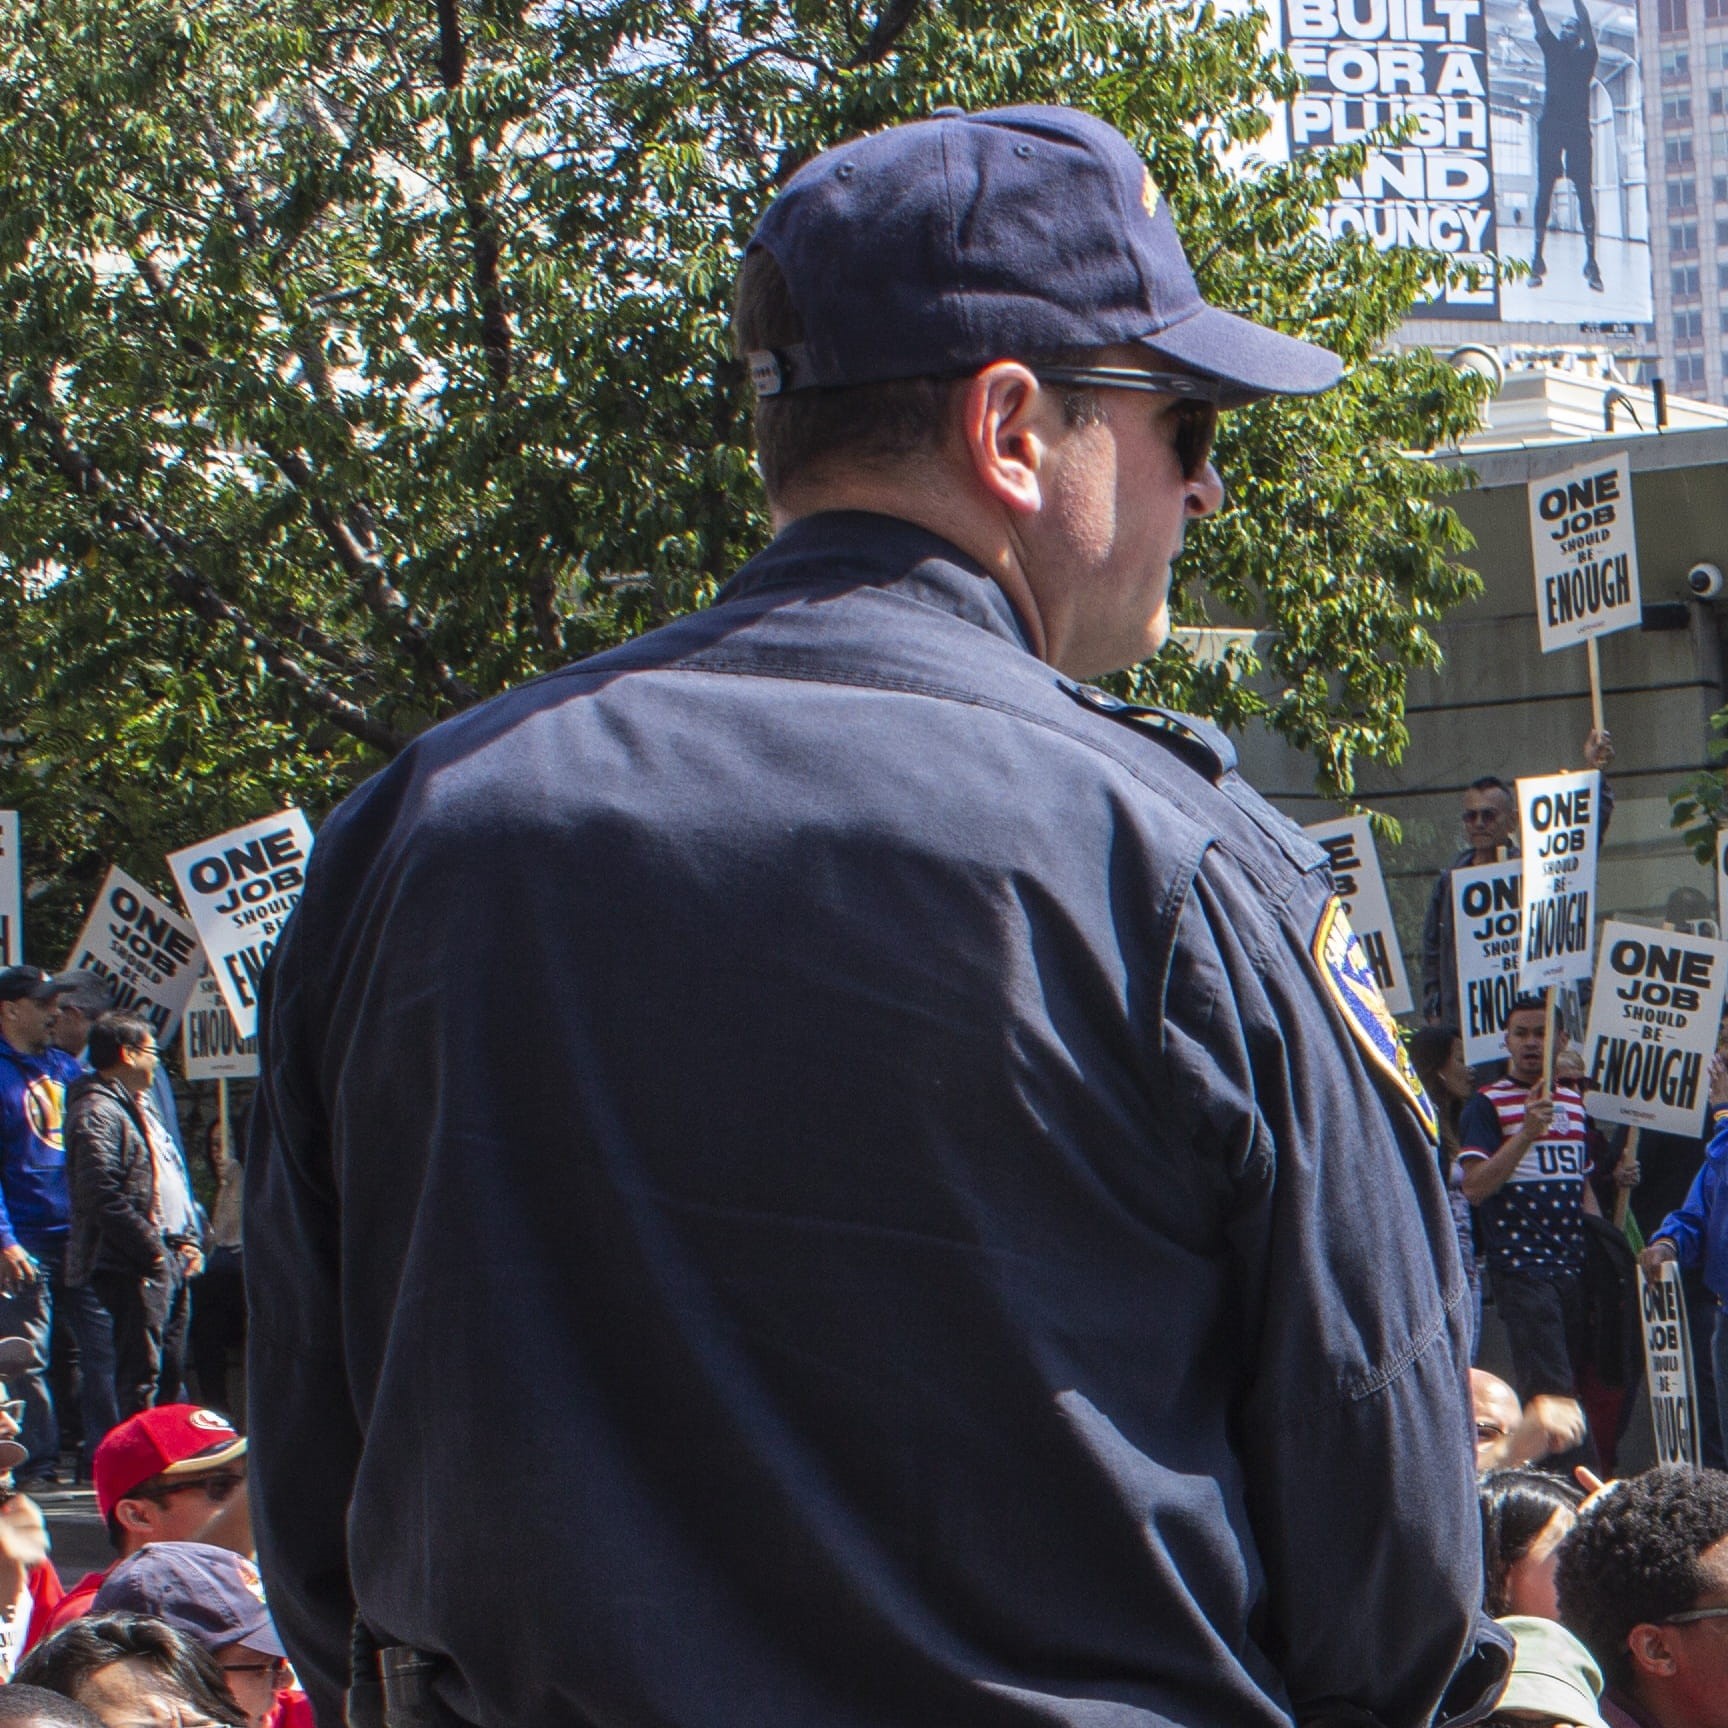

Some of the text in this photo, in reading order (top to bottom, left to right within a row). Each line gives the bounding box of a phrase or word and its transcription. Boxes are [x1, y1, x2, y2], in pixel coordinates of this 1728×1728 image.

[1289, 0, 1481, 41] BUILT
[1287, 39, 1486, 96] FOR A
[1539, 469, 1620, 522] ONE
[1551, 504, 1616, 541] JOB
[1560, 528, 1610, 555] SHOULD
[1578, 550, 1594, 564] BE
[1545, 552, 1631, 627] ENOUGH
[1530, 789, 1591, 832] ONE
[190, 828, 304, 894] ONE
[1539, 829, 1585, 858] JOB
[216, 866, 304, 914] JOB
[1553, 879, 1566, 893] BE
[110, 887, 197, 966] ONE
[1526, 891, 1589, 963] ENOUGH
[110, 922, 177, 978] JOB
[111, 940, 162, 985] SHOULD
[1610, 940, 1714, 990] ONE
[120, 966, 140, 984] BE
[1616, 981, 1700, 1012] JOB
[1623, 1004, 1688, 1029] SHOULD
[1641, 1026, 1664, 1042] BE
[1595, 1035, 1702, 1111] ENOUGH
